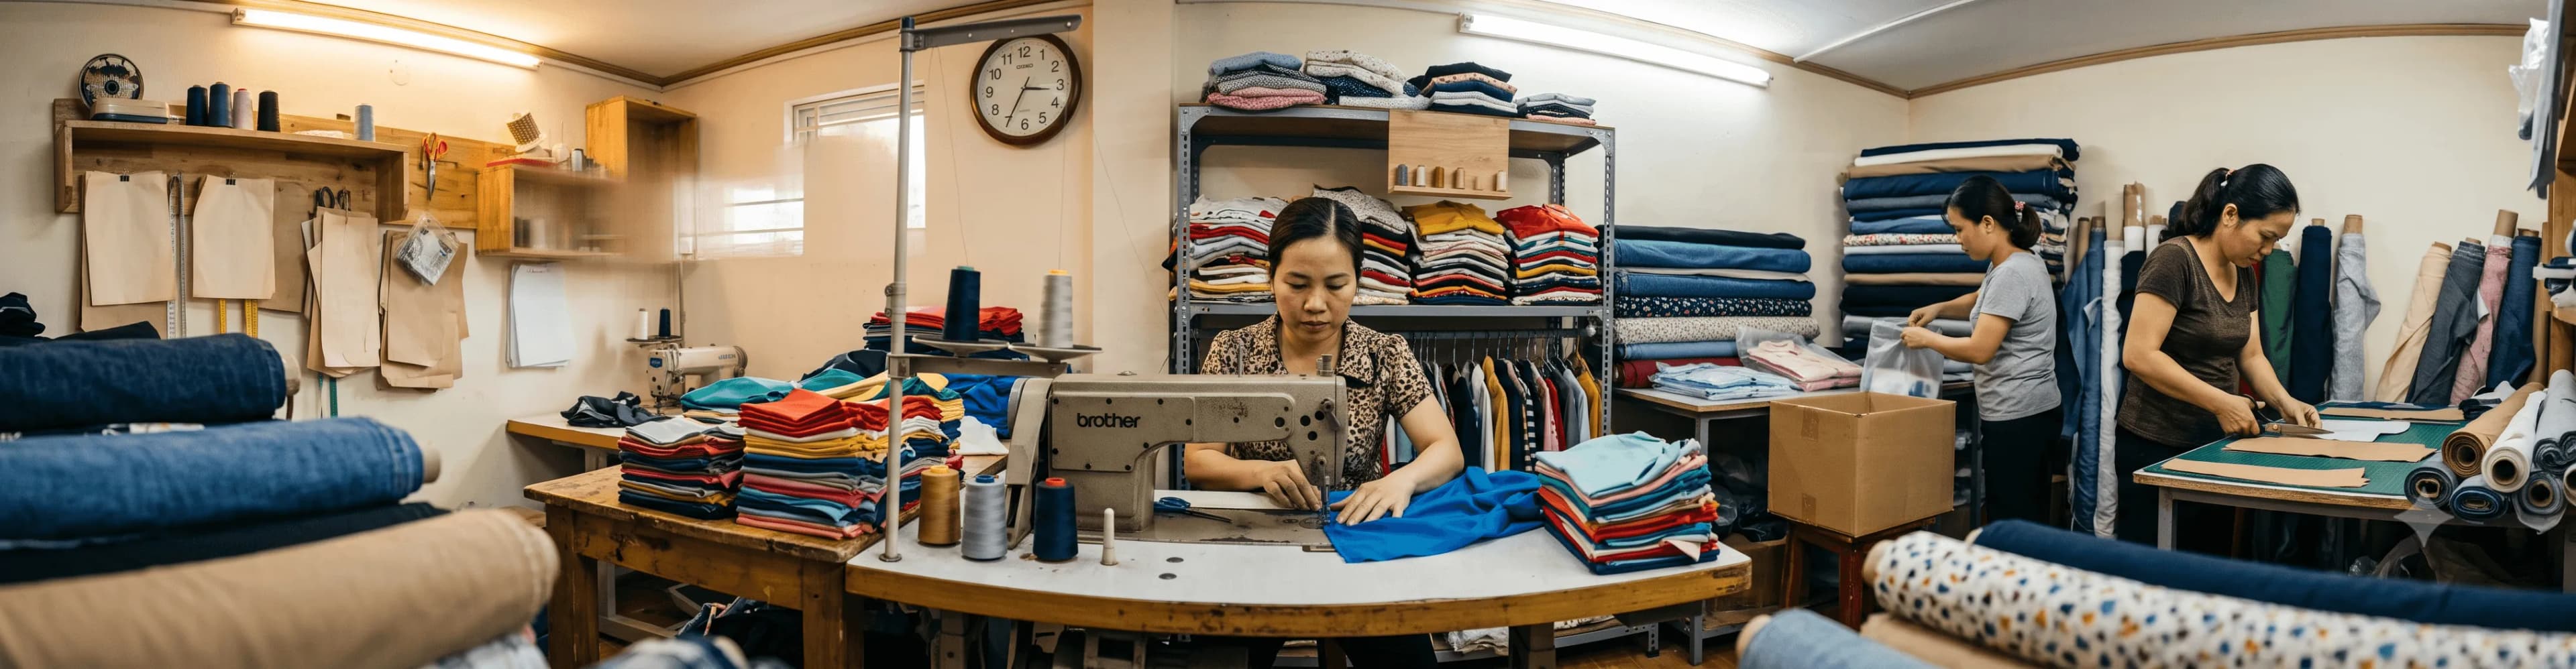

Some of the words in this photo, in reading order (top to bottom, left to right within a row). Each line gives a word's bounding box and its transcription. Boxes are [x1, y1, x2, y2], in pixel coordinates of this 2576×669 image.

[1018, 46, 1031, 58] 12
[1039, 48, 1045, 60] 1
[1001, 53, 1012, 65] 11
[1051, 60, 1059, 73] 2
[989, 68, 1002, 80] 10
[1056, 78, 1065, 91] 3
[985, 86, 994, 99] 9
[1051, 97, 1060, 109] 4
[991, 103, 1000, 116] 8
[1038, 111, 1046, 124] 5
[1020, 118, 1029, 130] 6
[1077, 412, 1141, 428] brother
